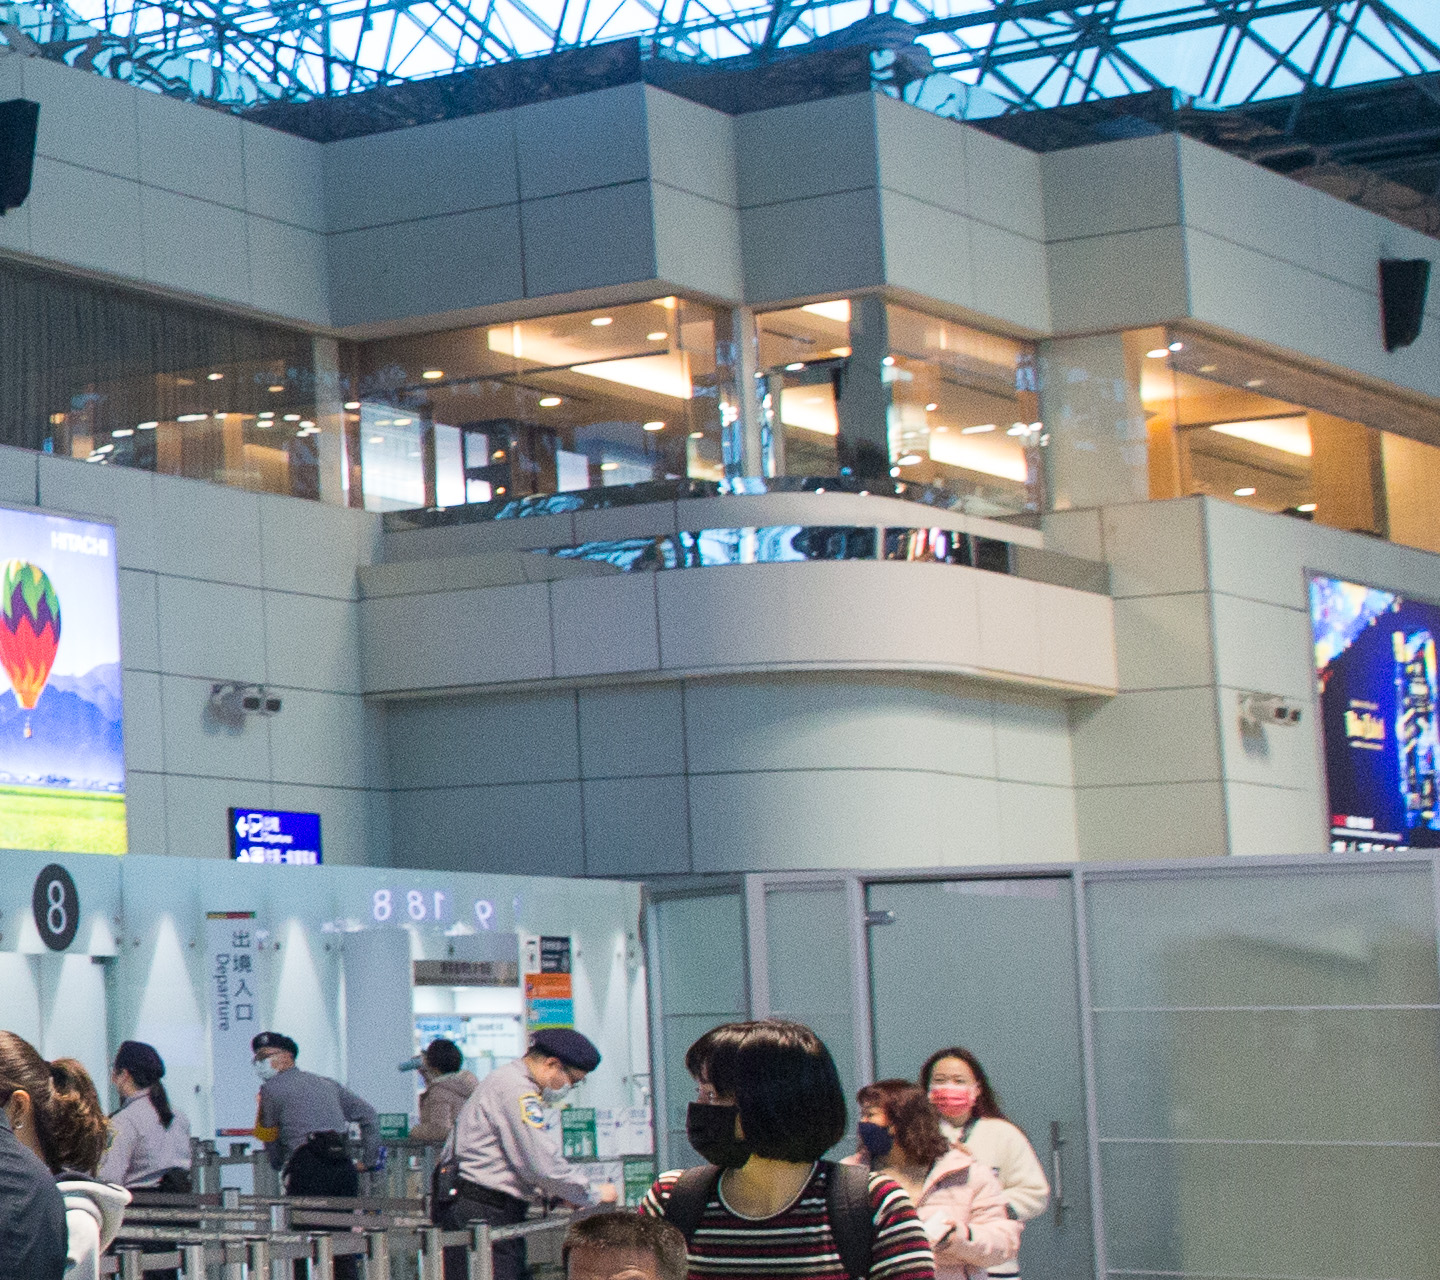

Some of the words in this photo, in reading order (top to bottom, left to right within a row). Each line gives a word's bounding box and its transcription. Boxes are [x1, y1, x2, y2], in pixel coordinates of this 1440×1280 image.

[51, 531, 108, 556] HITACHI
[47, 879, 67, 934] 8
[213, 952, 230, 1032] Departure
[232, 929, 253, 1021] 出境入口
